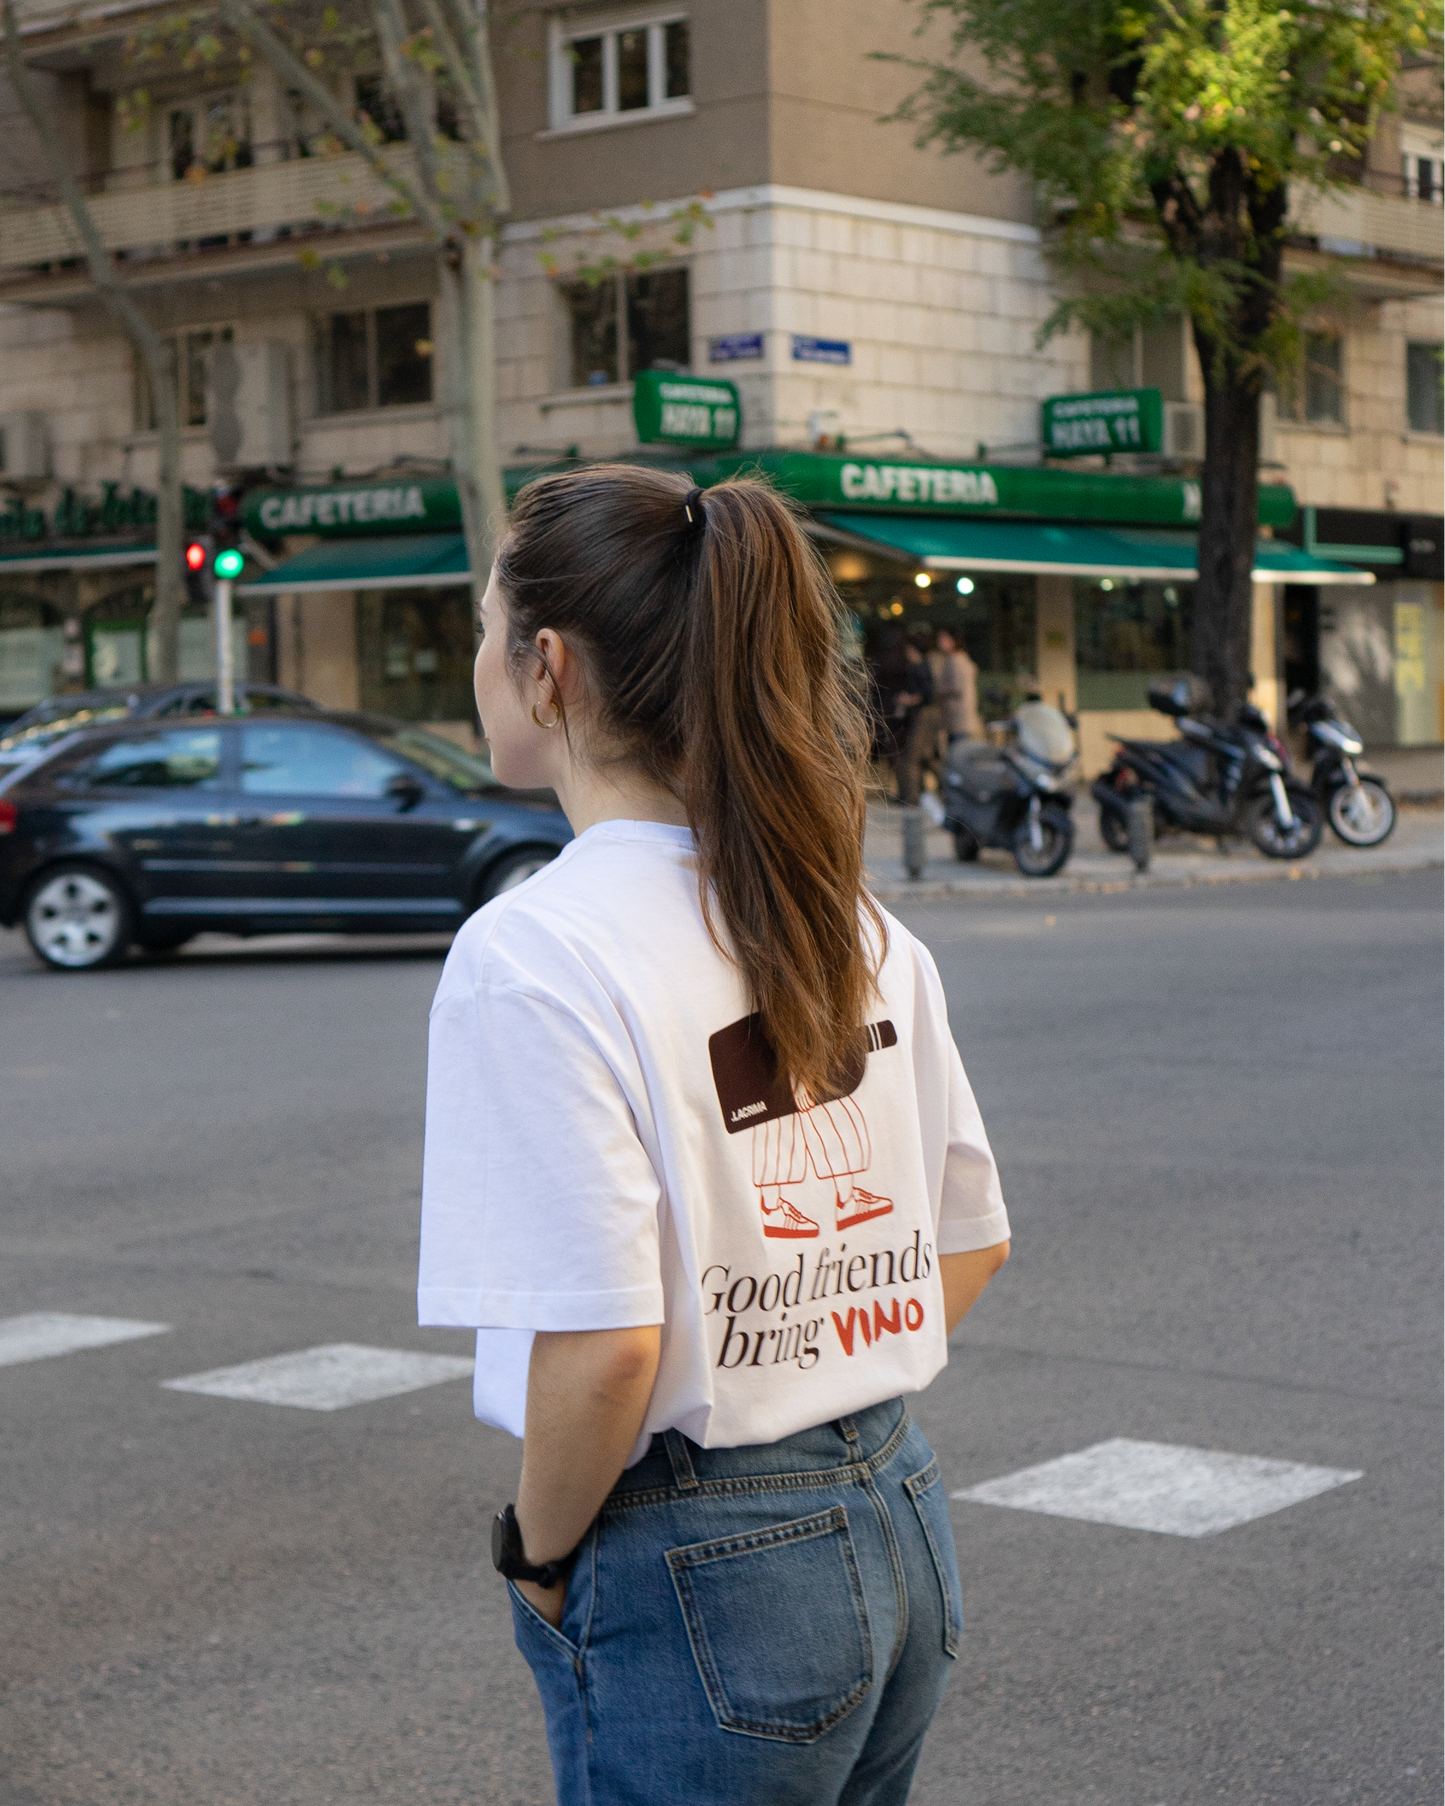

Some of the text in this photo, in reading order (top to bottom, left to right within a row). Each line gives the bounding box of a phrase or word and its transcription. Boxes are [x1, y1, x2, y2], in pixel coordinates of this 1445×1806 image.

[260, 486, 426, 529] CAFETERIA
[840, 463, 999, 504] CAFETERIA
[701, 1229, 932, 1315] Good friends
[716, 1297, 924, 1369] bring VINO
